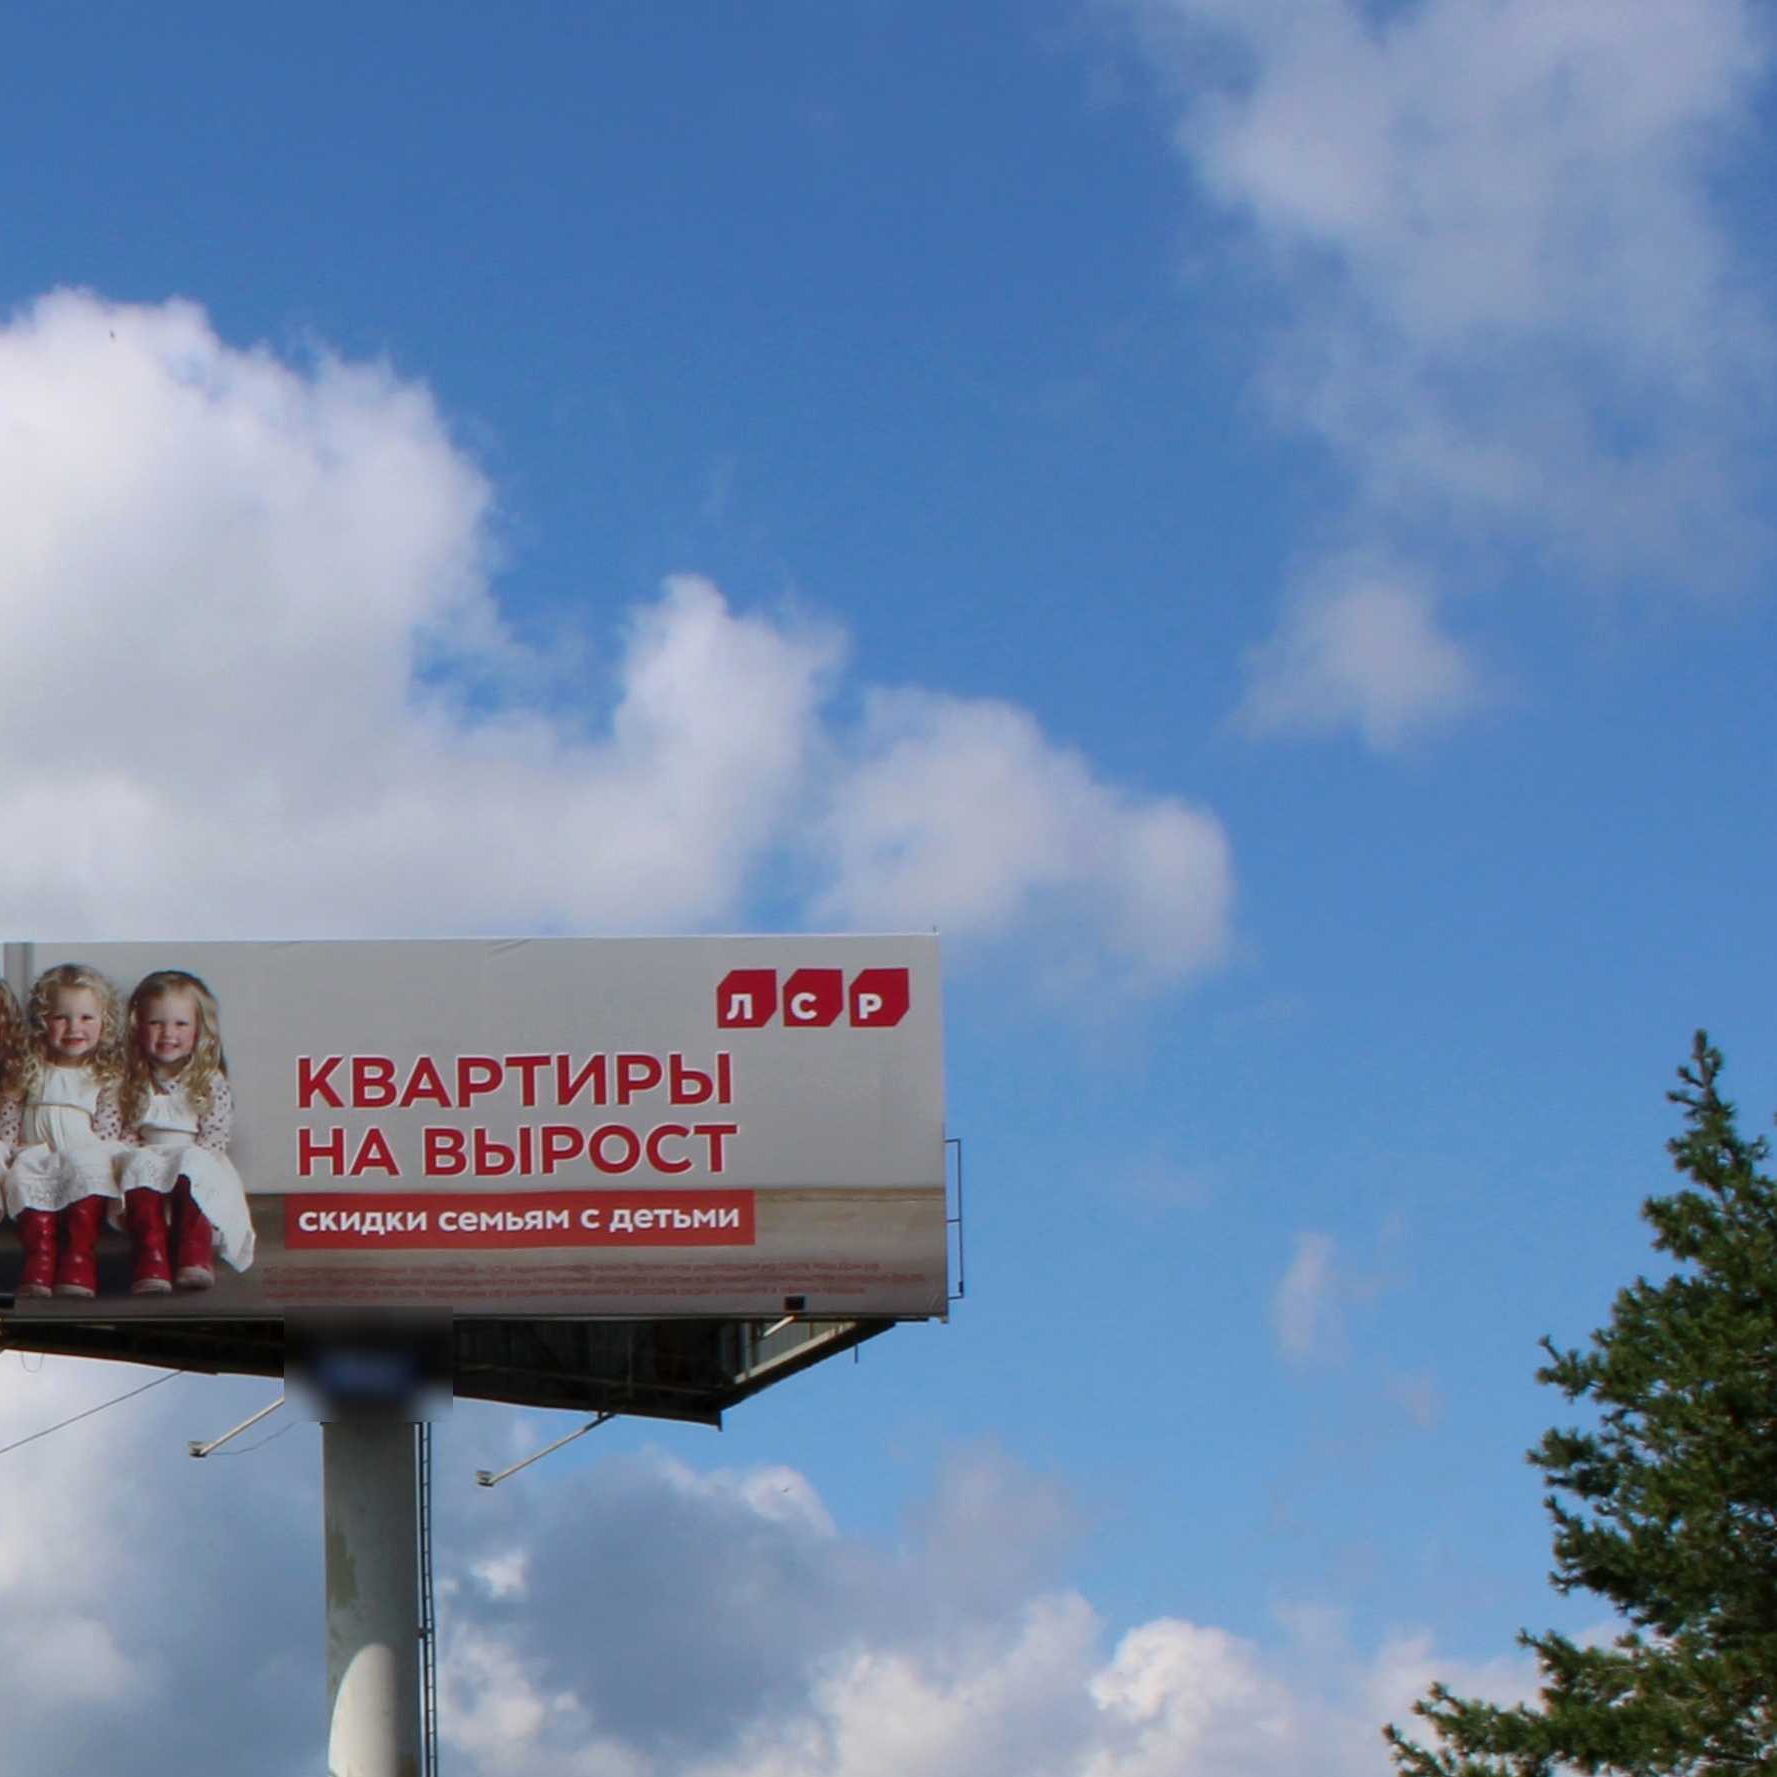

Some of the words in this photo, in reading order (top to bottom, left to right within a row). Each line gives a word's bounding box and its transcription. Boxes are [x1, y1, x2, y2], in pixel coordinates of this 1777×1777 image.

[296, 1052, 733, 1109] КВАРТИРЫ
[296, 1127, 400, 1177] НА
[422, 1123, 739, 1177] ВЫРОСТ
[298, 1210, 428, 1235] скидки
[437, 1208, 570, 1232] семьям
[579, 1207, 601, 1230] с
[608, 1206, 741, 1233] детьми
